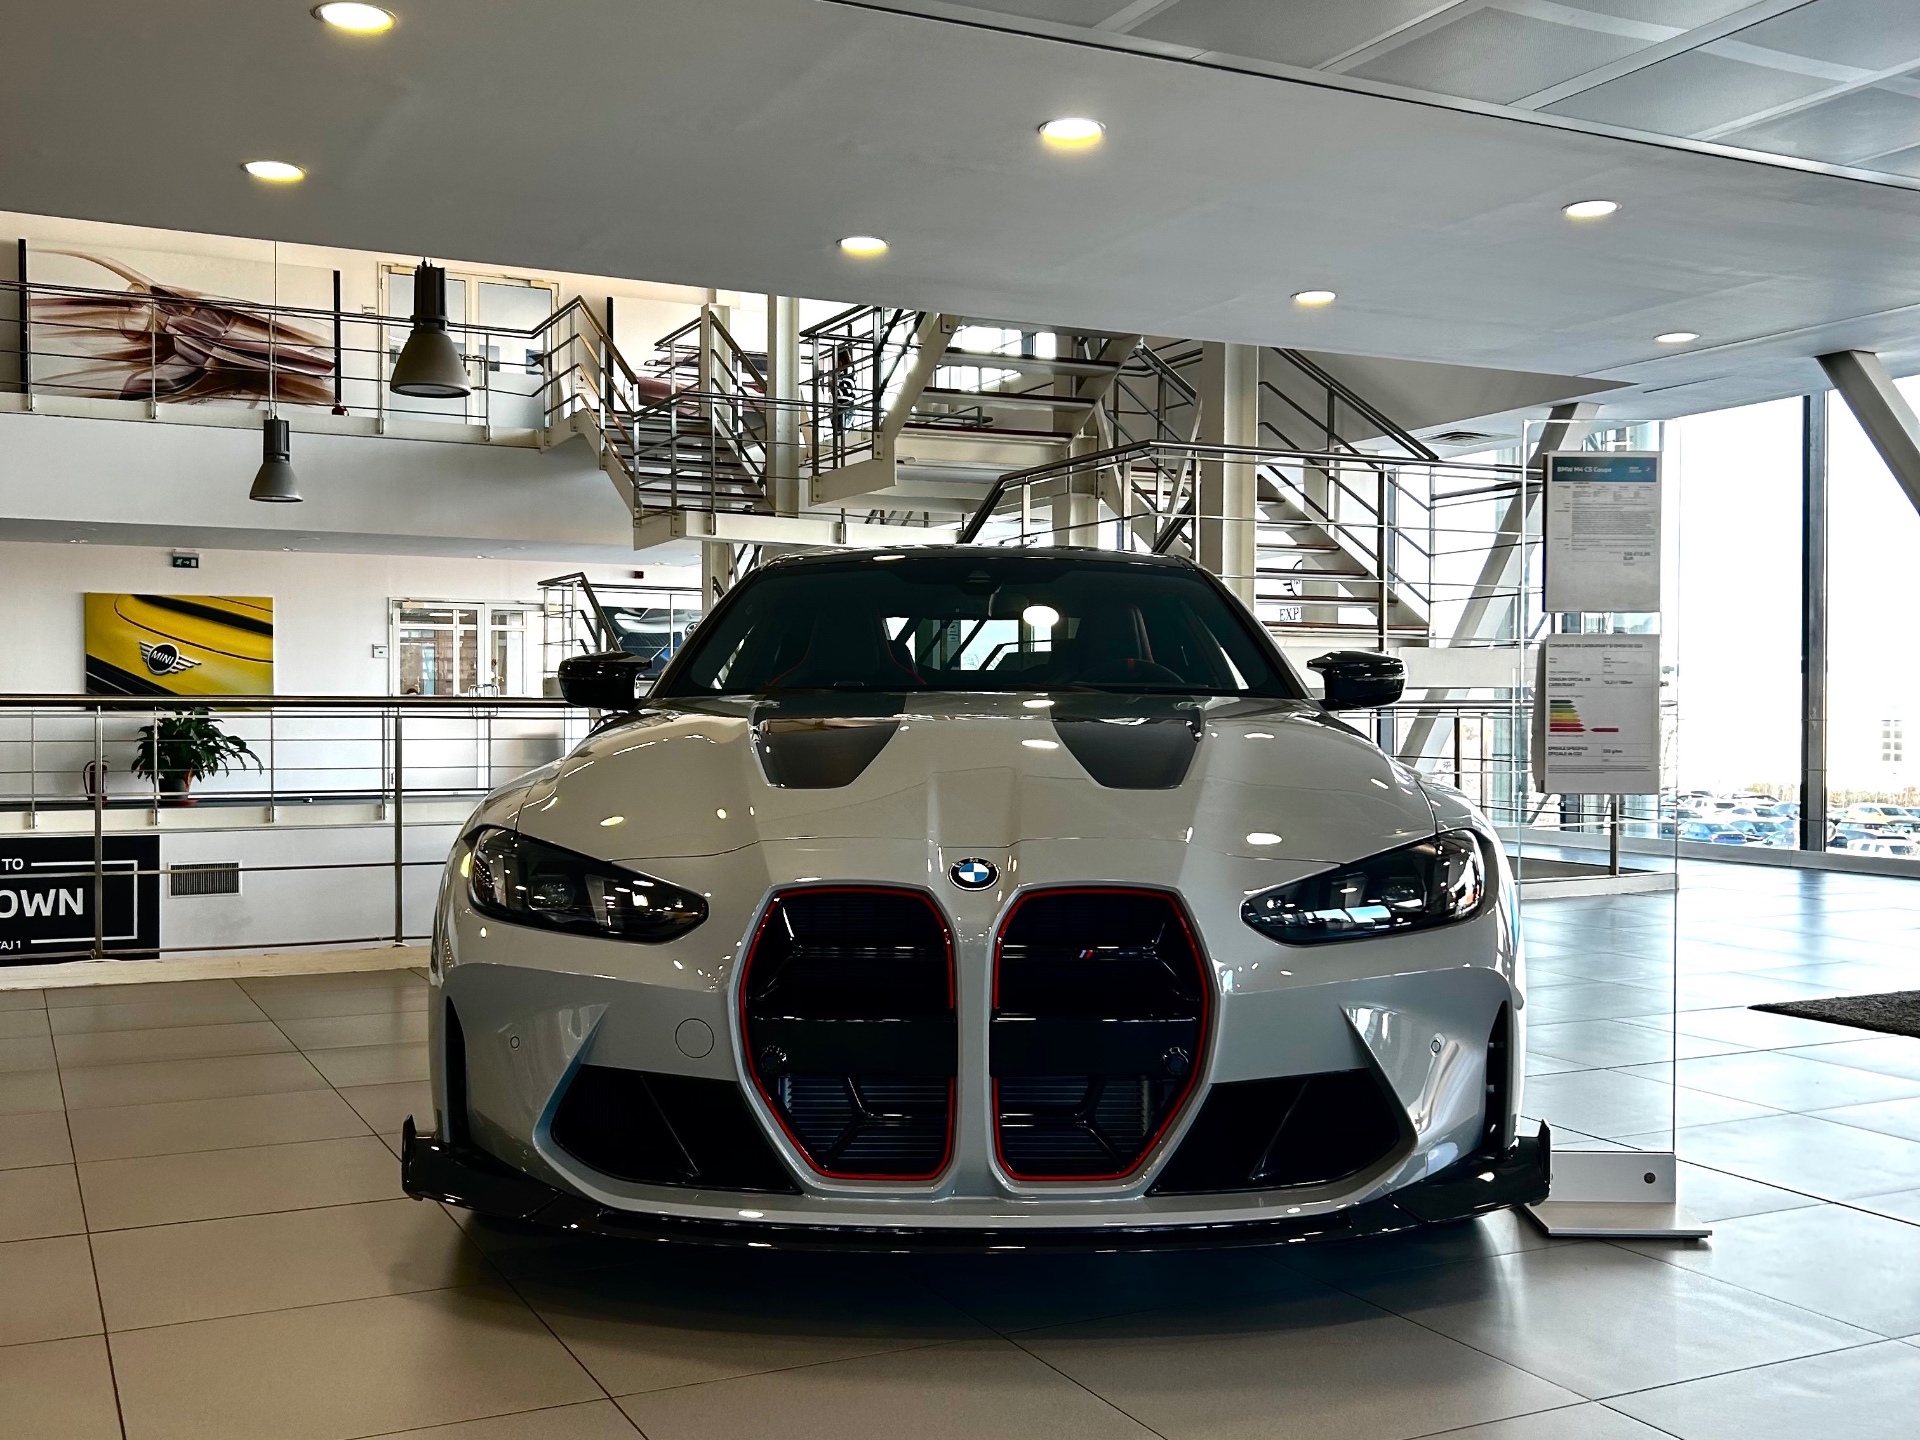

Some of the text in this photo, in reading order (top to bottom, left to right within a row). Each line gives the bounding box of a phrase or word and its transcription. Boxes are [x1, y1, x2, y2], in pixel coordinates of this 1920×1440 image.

[151, 650, 174, 665] MINI
[1, 858, 24, 871] TO
[0, 888, 83, 918] OWN
[16, 940, 21, 949] 1
